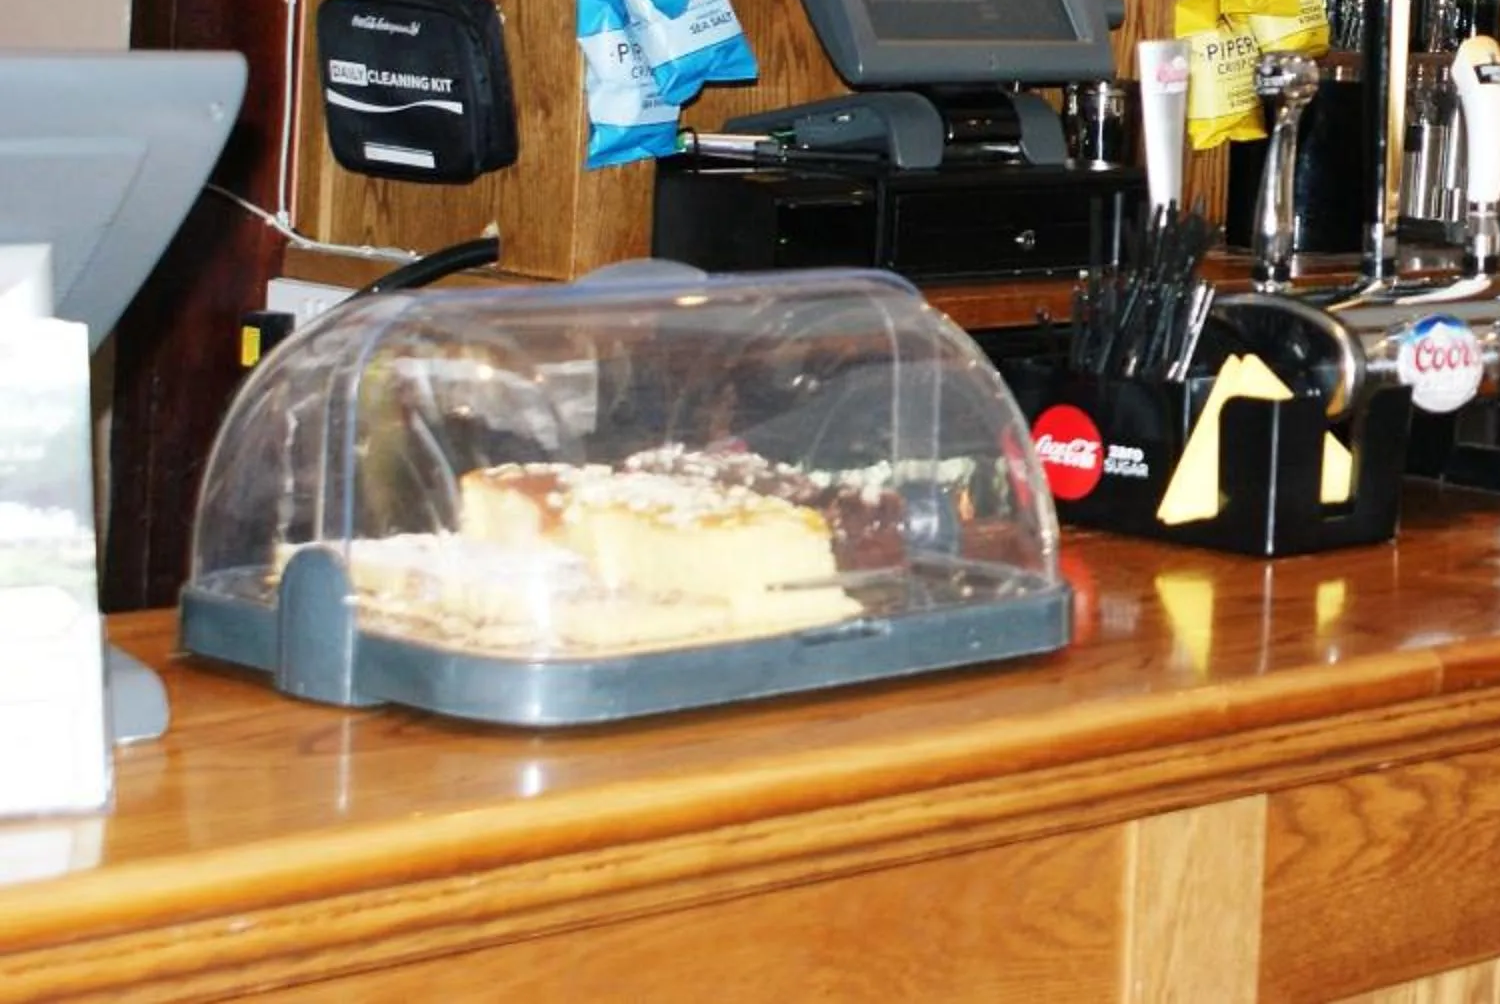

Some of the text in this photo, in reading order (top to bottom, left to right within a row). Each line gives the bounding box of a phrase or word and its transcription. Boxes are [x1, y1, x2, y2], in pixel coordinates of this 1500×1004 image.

[367, 69, 429, 92] CLEANING
[431, 77, 454, 93] KIT
[1104, 457, 1149, 479] SUGAR
